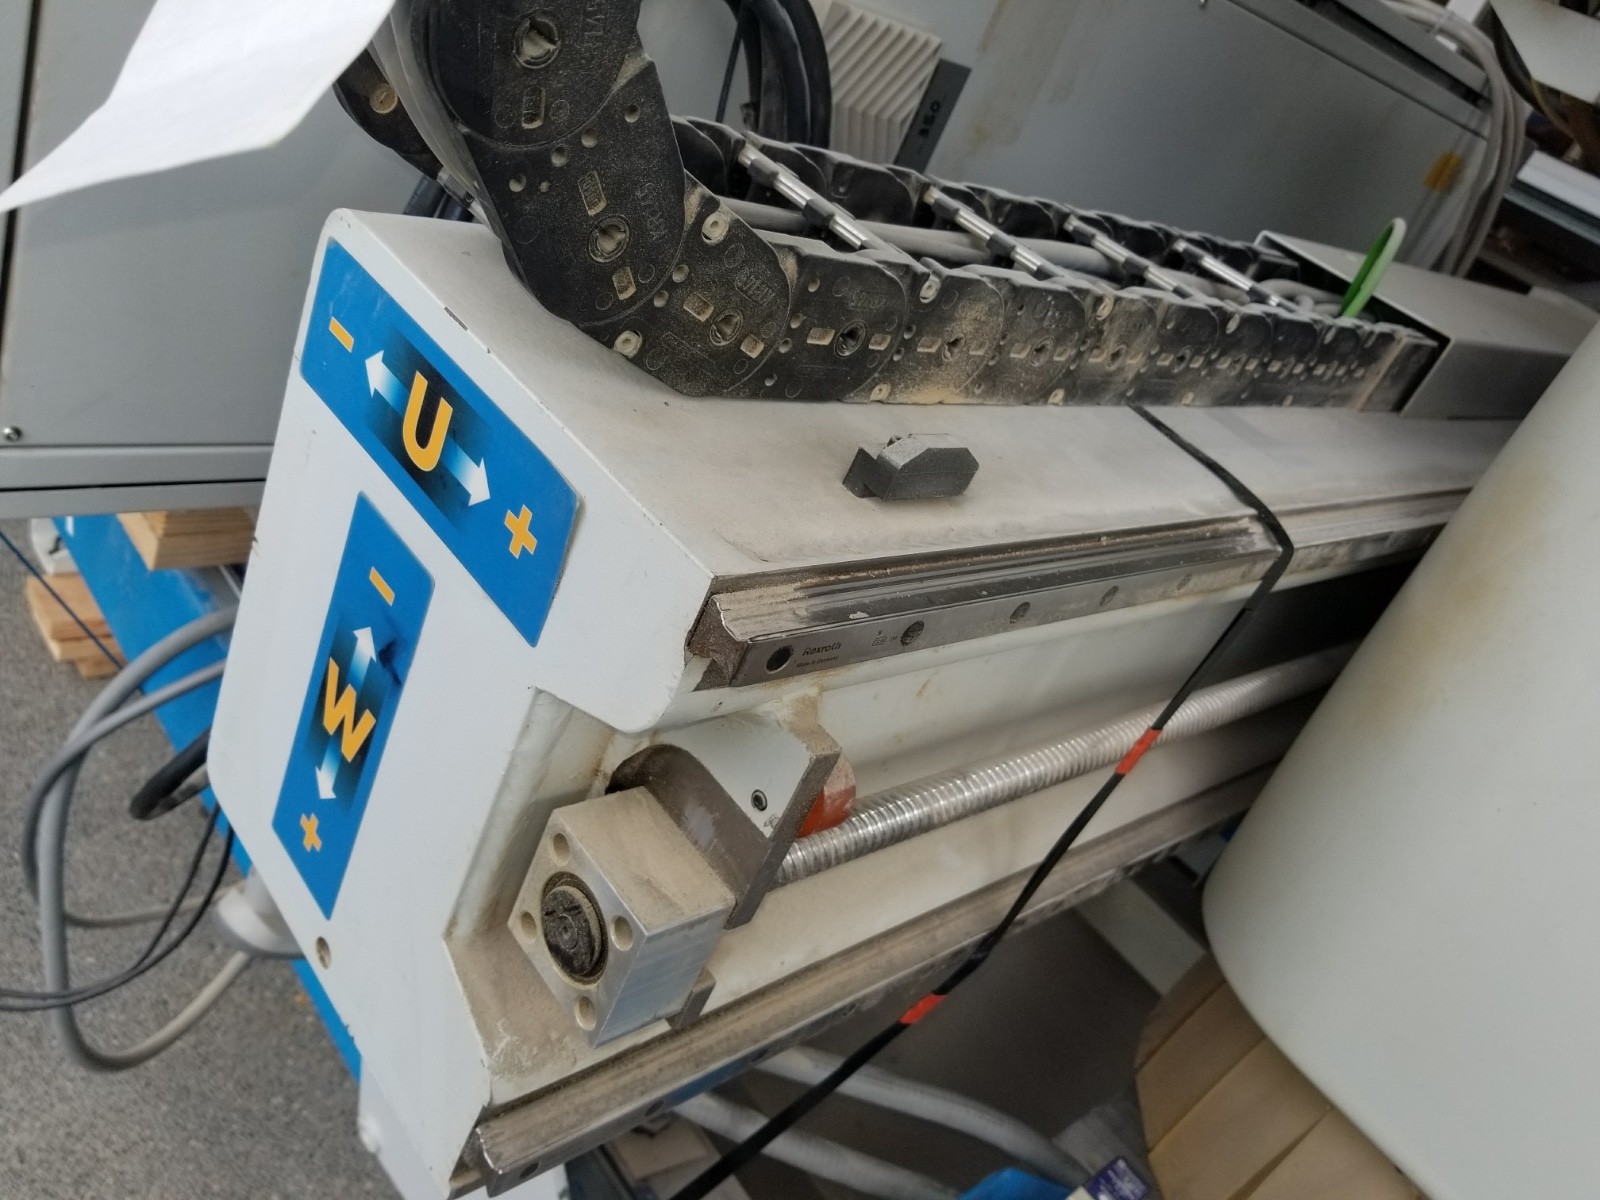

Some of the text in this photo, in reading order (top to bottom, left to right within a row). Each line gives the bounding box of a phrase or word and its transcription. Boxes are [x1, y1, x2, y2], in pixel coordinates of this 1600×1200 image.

[401, 371, 454, 472] U
[802, 641, 842, 656] Rexroth
[321, 657, 378, 764] W
